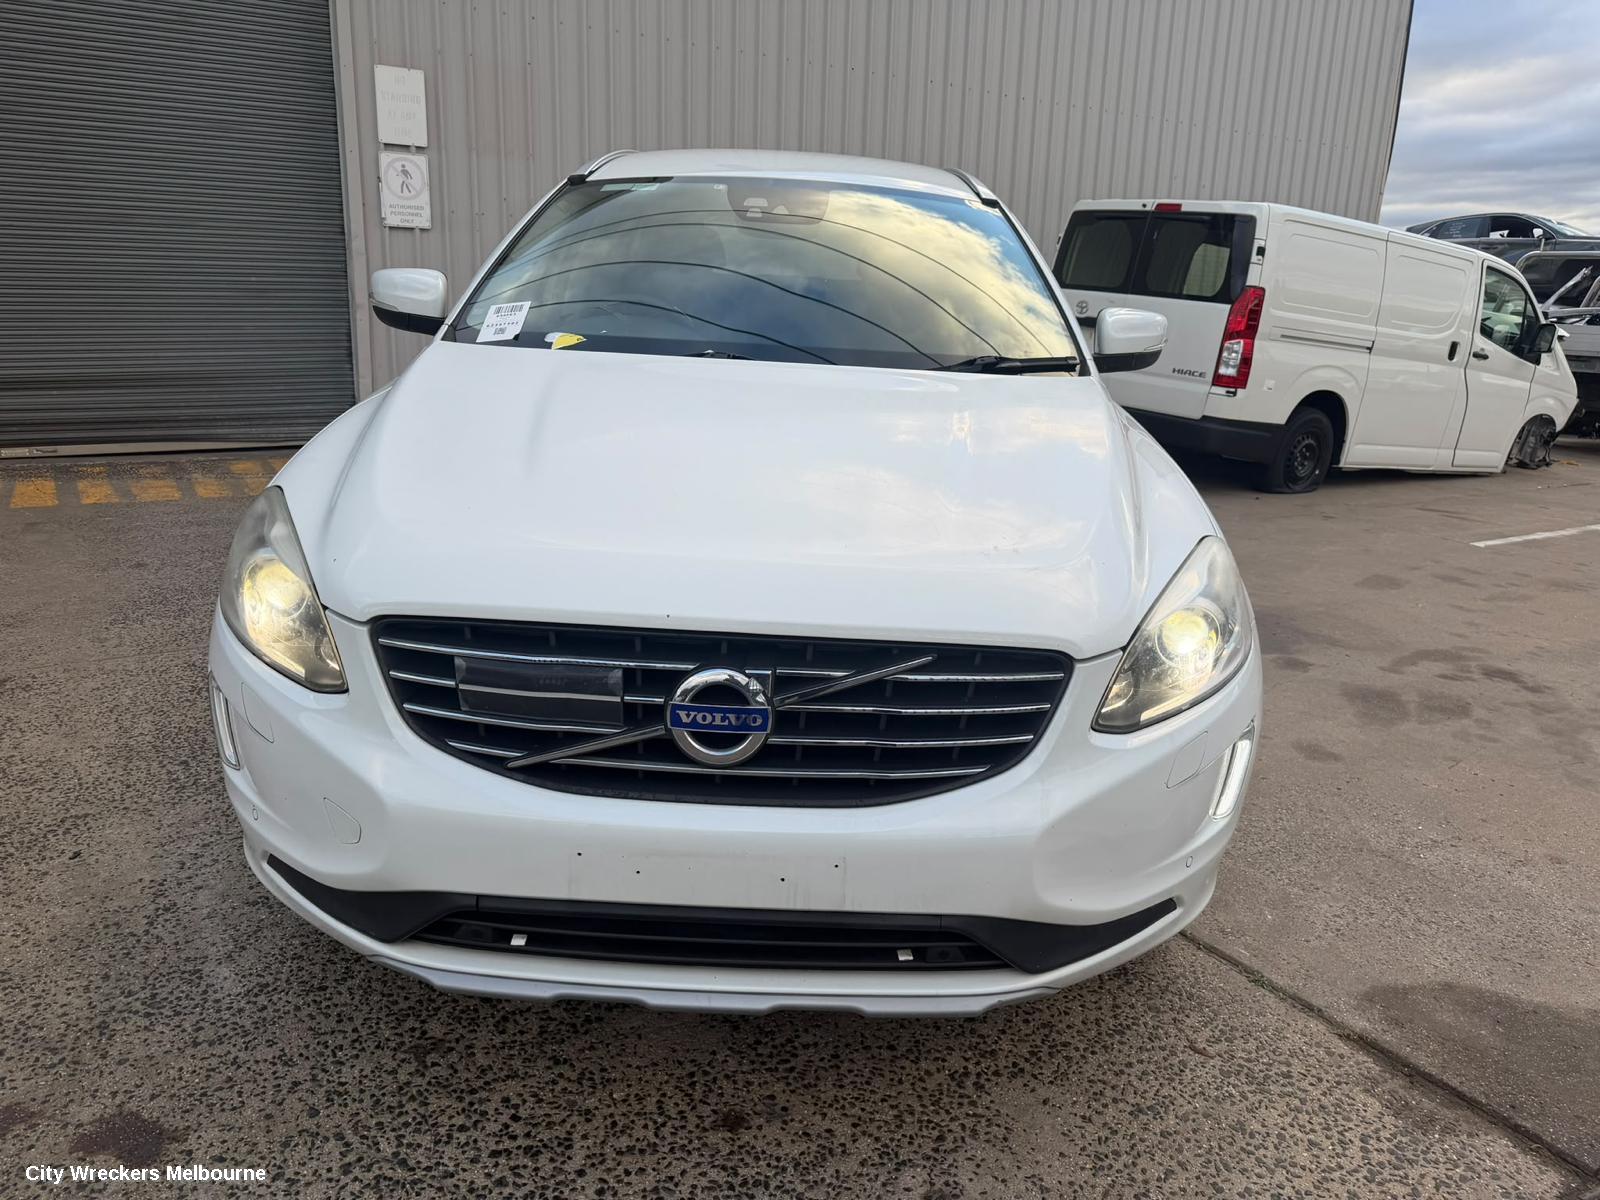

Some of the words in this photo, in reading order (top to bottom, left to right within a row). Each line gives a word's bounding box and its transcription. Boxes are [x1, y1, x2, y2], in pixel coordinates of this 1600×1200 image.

[389, 203, 425, 211] AUTHORISED
[390, 210, 423, 218] PERSONNEL
[1172, 367, 1207, 379] HIACE
[675, 710, 763, 727] VOLVO
